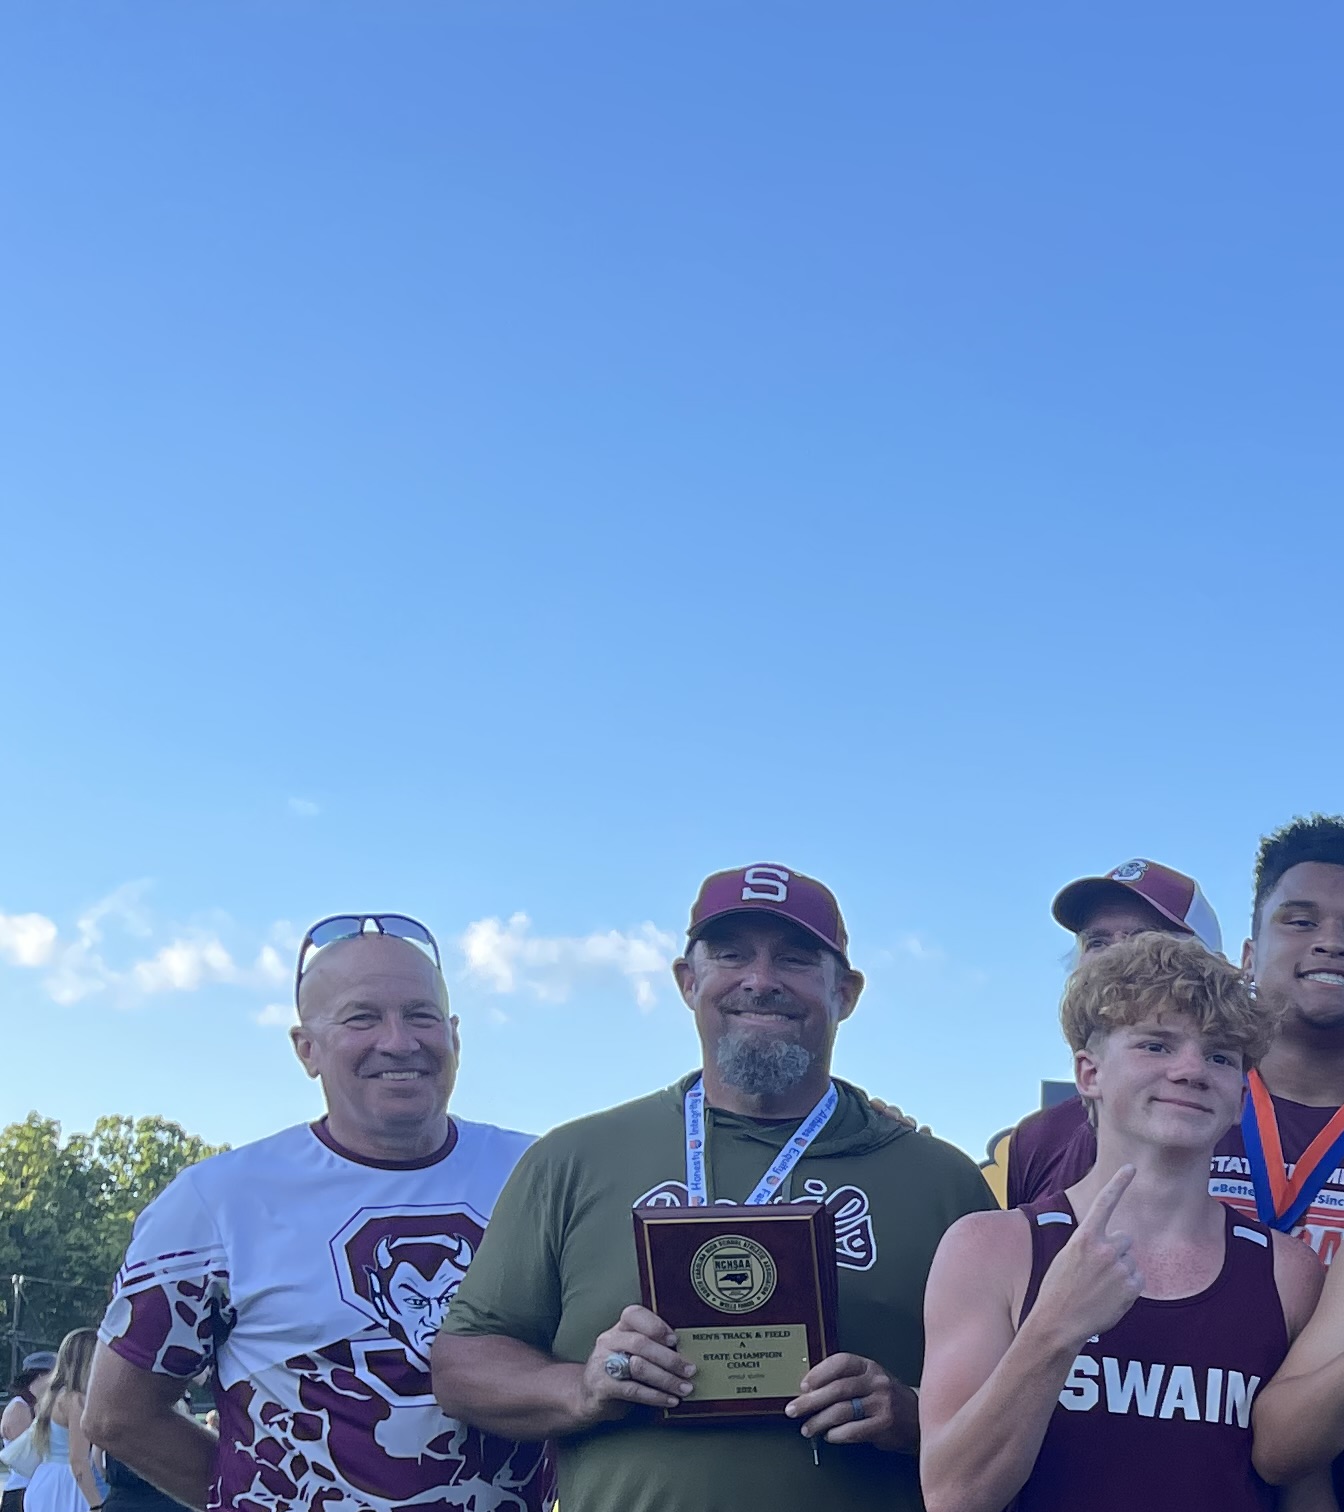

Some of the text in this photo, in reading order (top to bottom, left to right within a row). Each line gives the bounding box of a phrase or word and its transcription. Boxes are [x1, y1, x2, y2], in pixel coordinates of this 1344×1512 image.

[742, 867, 789, 903] S
[689, 1098, 701, 1136] Integrity
[691, 1151, 703, 1191] Honesty
[772, 1147, 800, 1175] Equity
[715, 1260, 751, 1269] NCHSAA
[722, 1332, 752, 1340] TRACK
[755, 1331, 762, 1339] &
[764, 1330, 791, 1338] FIELD
[703, 1351, 783, 1361] STATE CHAMPION
[727, 1361, 760, 1369] COACH
[1059, 1354, 1261, 1429] SWAIN
